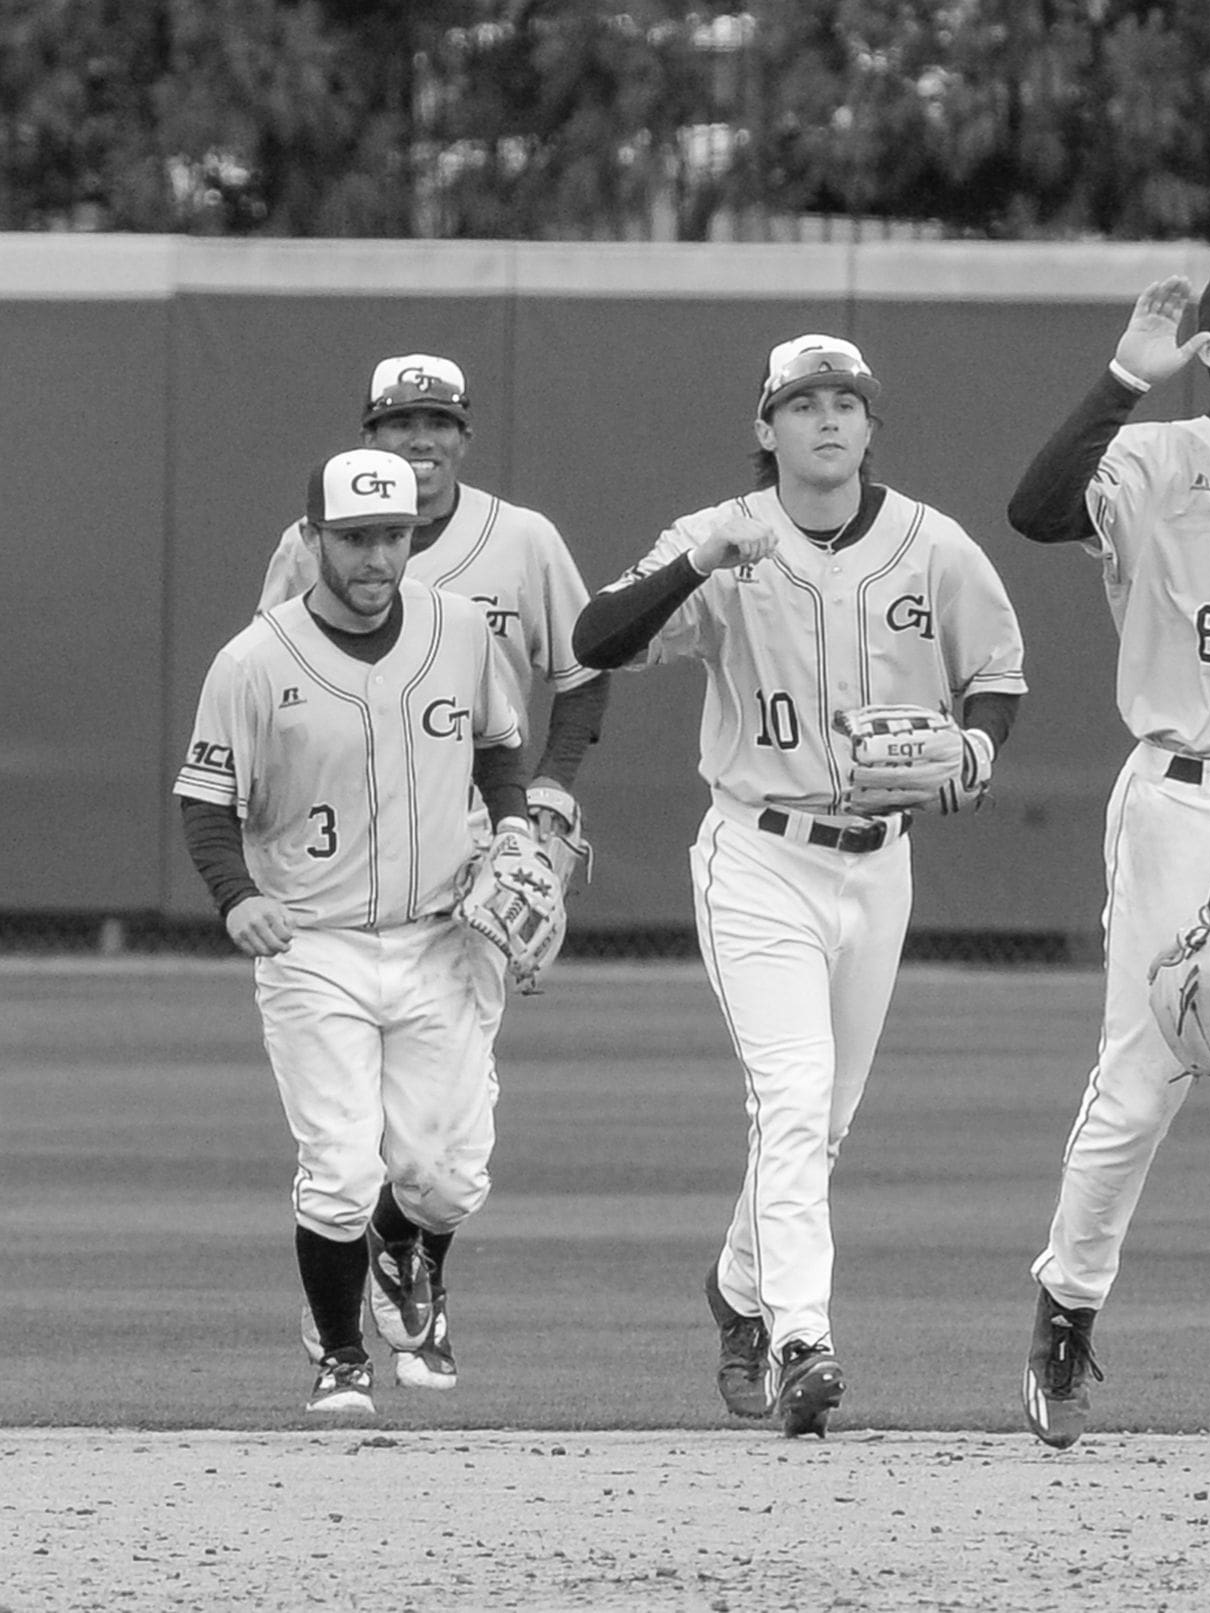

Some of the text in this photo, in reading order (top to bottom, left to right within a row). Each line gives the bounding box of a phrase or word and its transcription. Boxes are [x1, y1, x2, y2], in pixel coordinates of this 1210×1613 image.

[351, 472, 396, 499] GT
[886, 594, 935, 640] GT
[422, 696, 470, 741] GT
[755, 688, 800, 751] 10
[887, 742, 926, 757] EQT
[305, 803, 338, 859] 3
